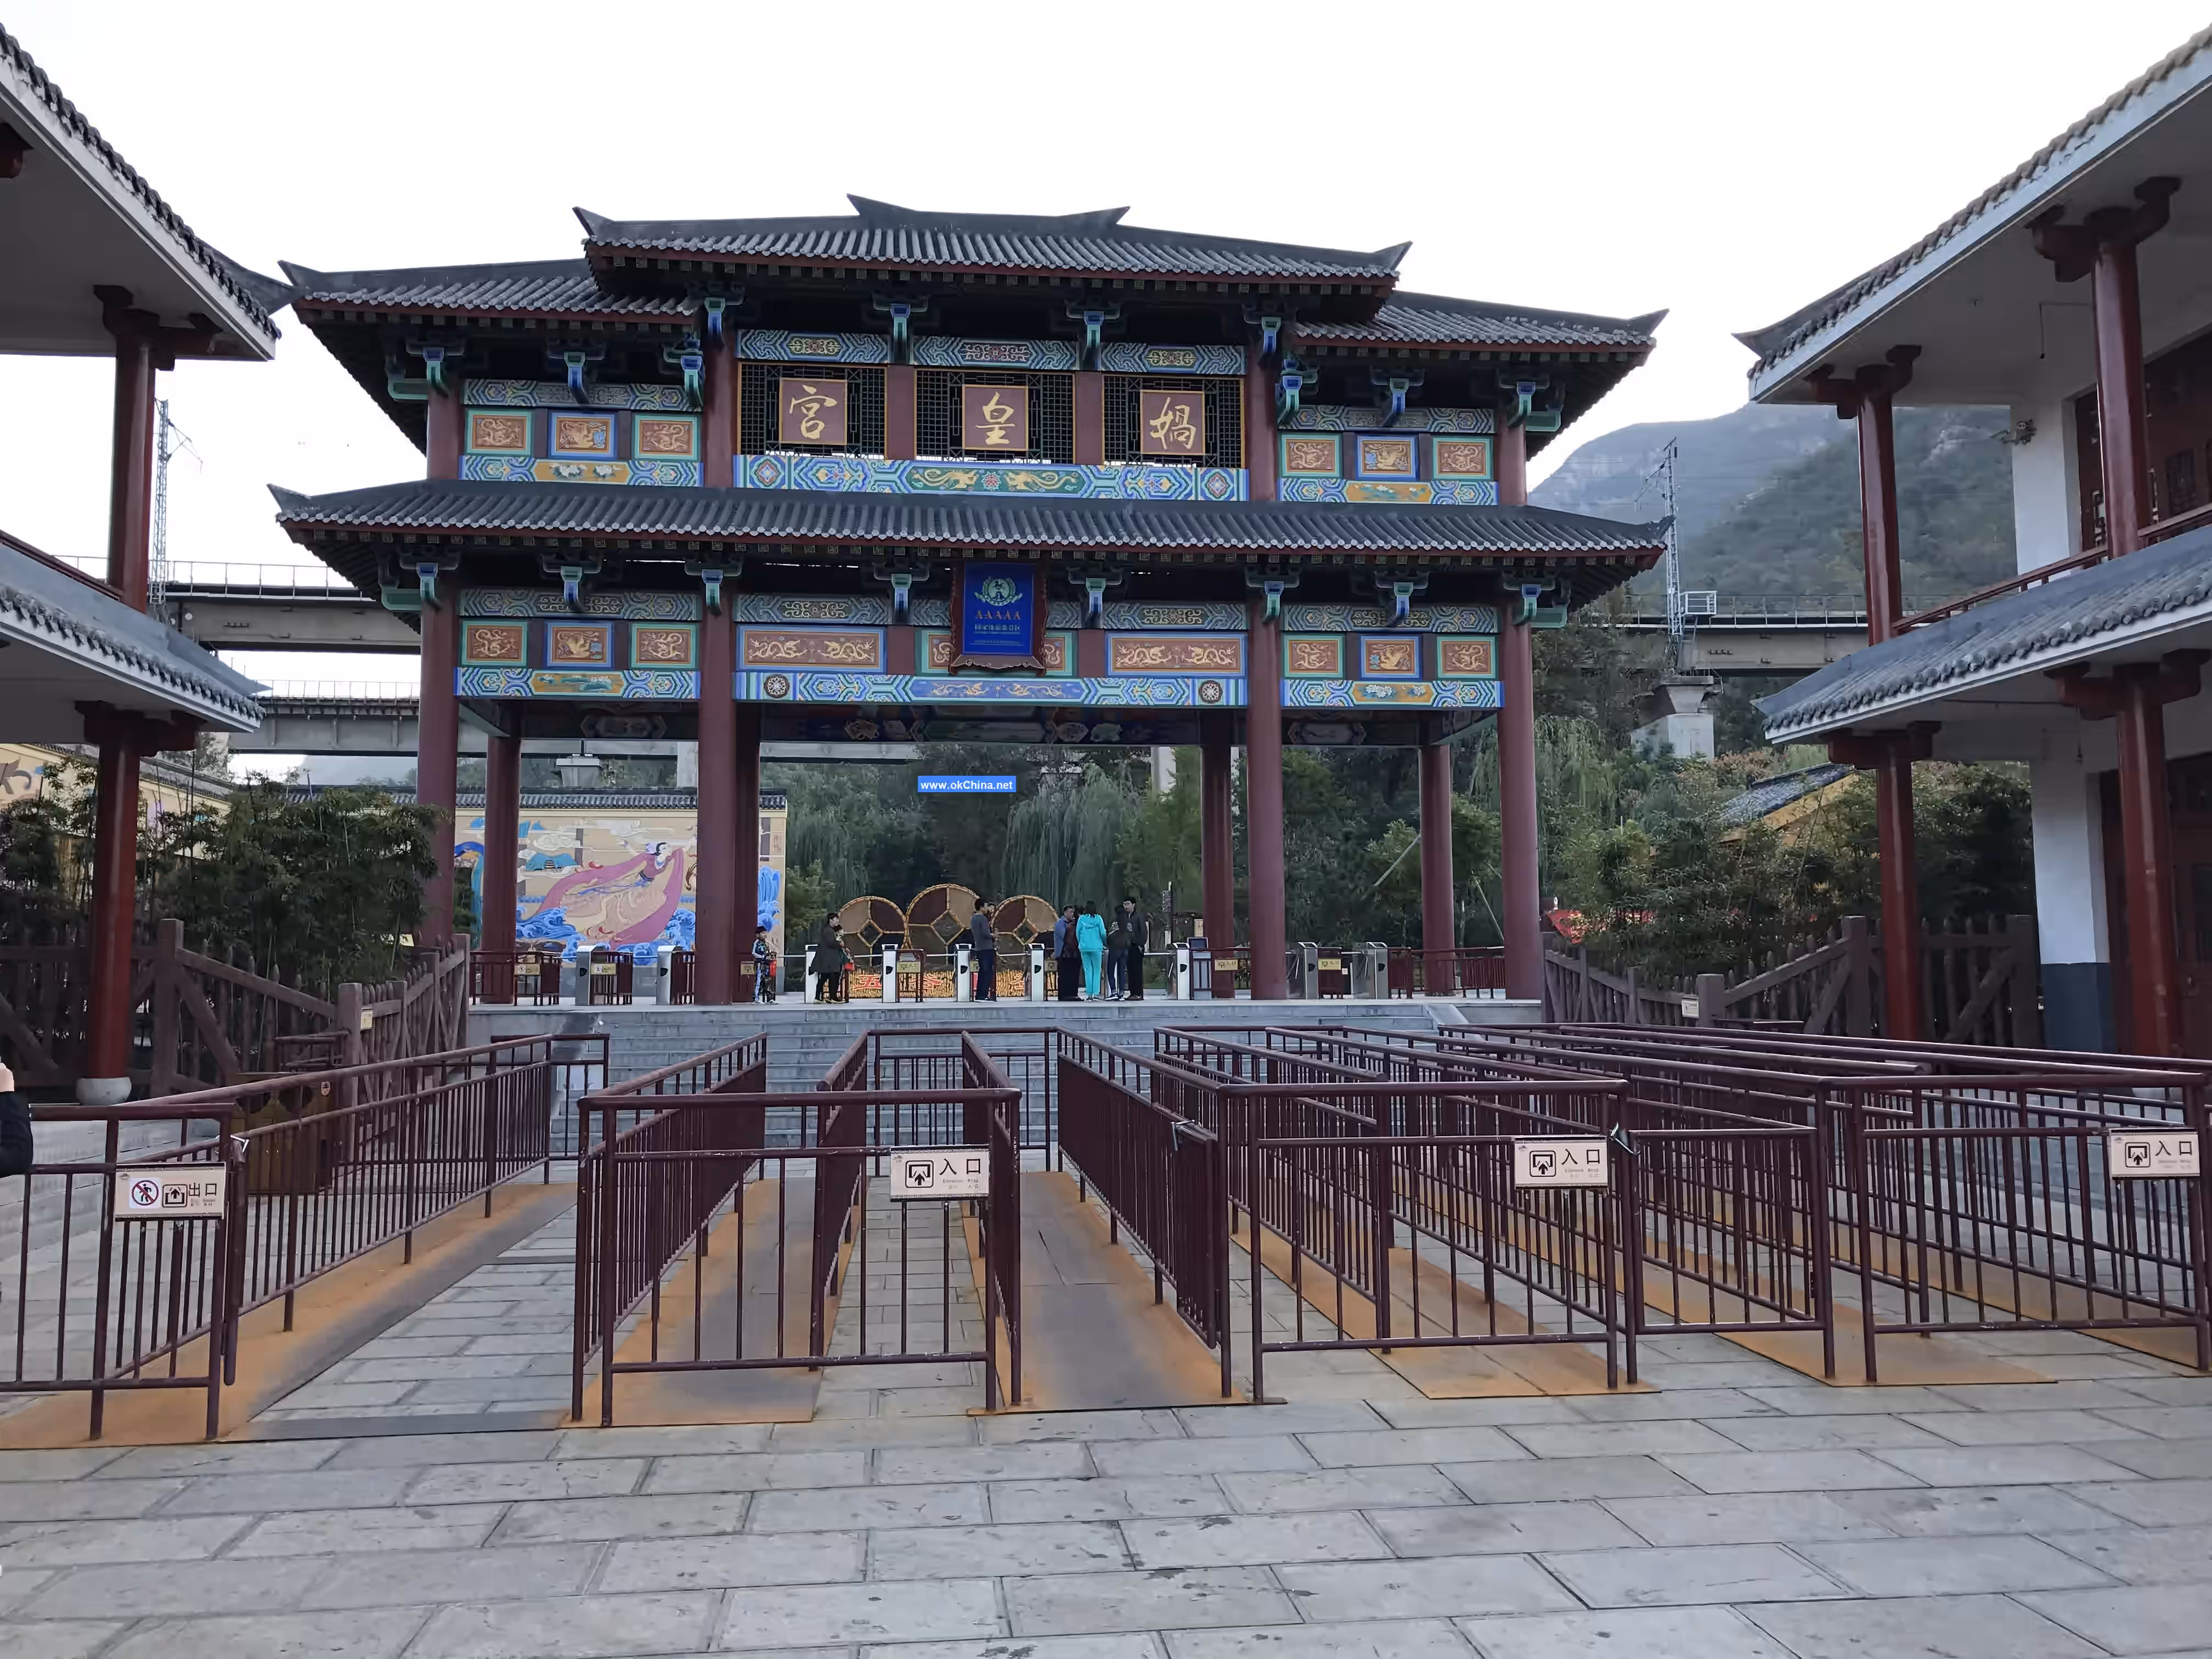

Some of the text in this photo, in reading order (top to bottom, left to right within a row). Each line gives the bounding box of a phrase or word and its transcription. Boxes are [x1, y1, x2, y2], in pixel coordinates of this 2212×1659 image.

[974, 391, 1015, 445] 皇
[1561, 1148, 1600, 1165] 入口
[2155, 1140, 2192, 1156] 入口
[939, 1158, 981, 1176] 入口
[188, 1182, 217, 1198] 出口
